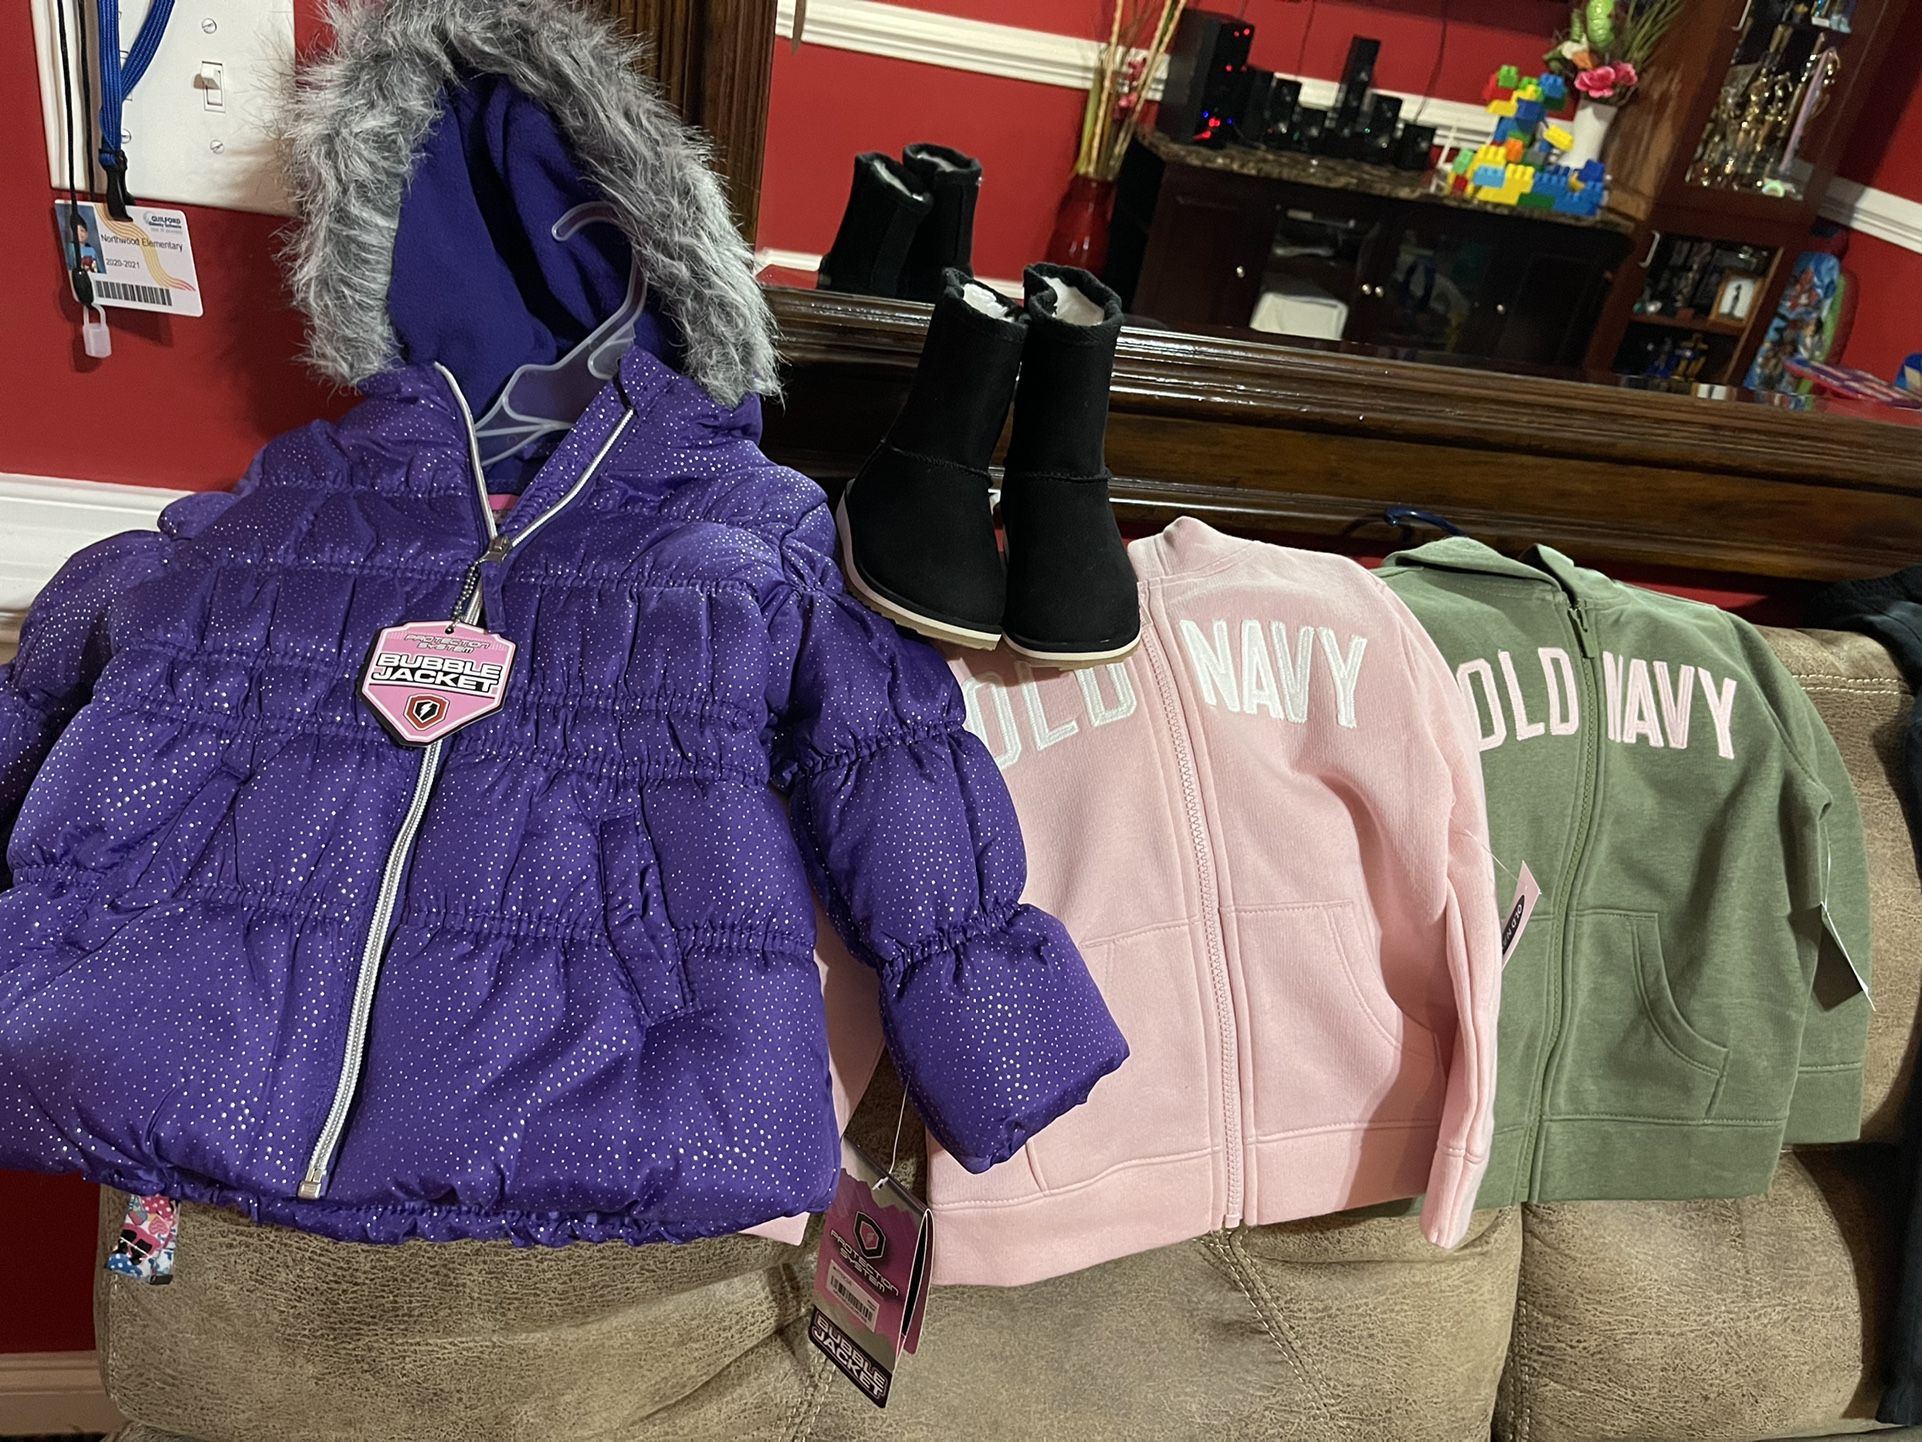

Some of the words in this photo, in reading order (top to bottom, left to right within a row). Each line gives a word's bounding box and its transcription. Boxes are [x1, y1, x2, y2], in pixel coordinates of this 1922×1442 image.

[101, 234, 140, 247] Northwood
[141, 237, 183, 252] Elementary
[105, 258, 140, 269] 2020-2021
[377, 652, 503, 679] BUBBLE
[417, 642, 475, 654] SYSTEM
[371, 666, 499, 693] JACKET
[1179, 618, 1367, 730] NAVY
[1456, 647, 1580, 752] OLD
[1511, 904, 1522, 928] OLD
[830, 1229, 900, 1297] PROTECTION
[839, 1248, 886, 1293] SYSTEM
[811, 1326, 884, 1399] JACKET
[815, 1314, 887, 1390] BUBBLE
